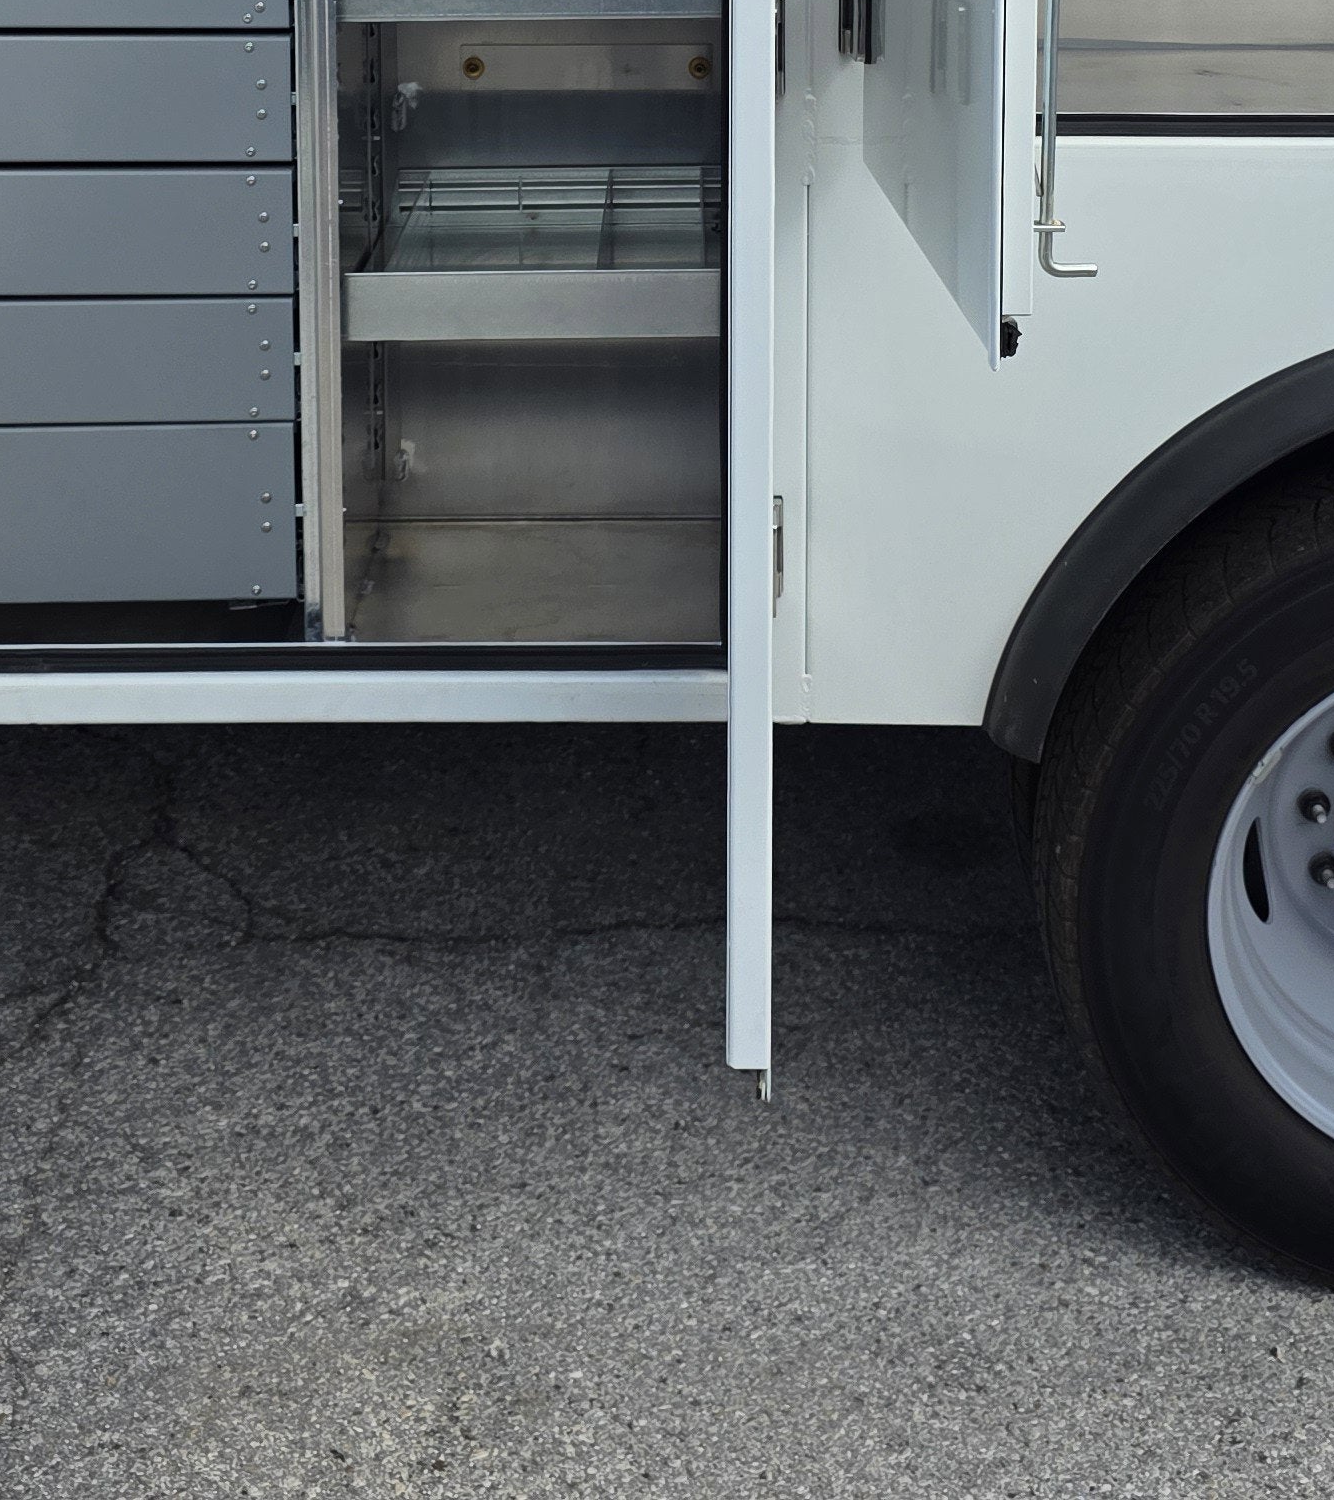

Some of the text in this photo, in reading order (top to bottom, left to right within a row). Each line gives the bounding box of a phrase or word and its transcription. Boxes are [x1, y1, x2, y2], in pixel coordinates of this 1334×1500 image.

[1142, 658, 1259, 812] 225/70 R 19.5
